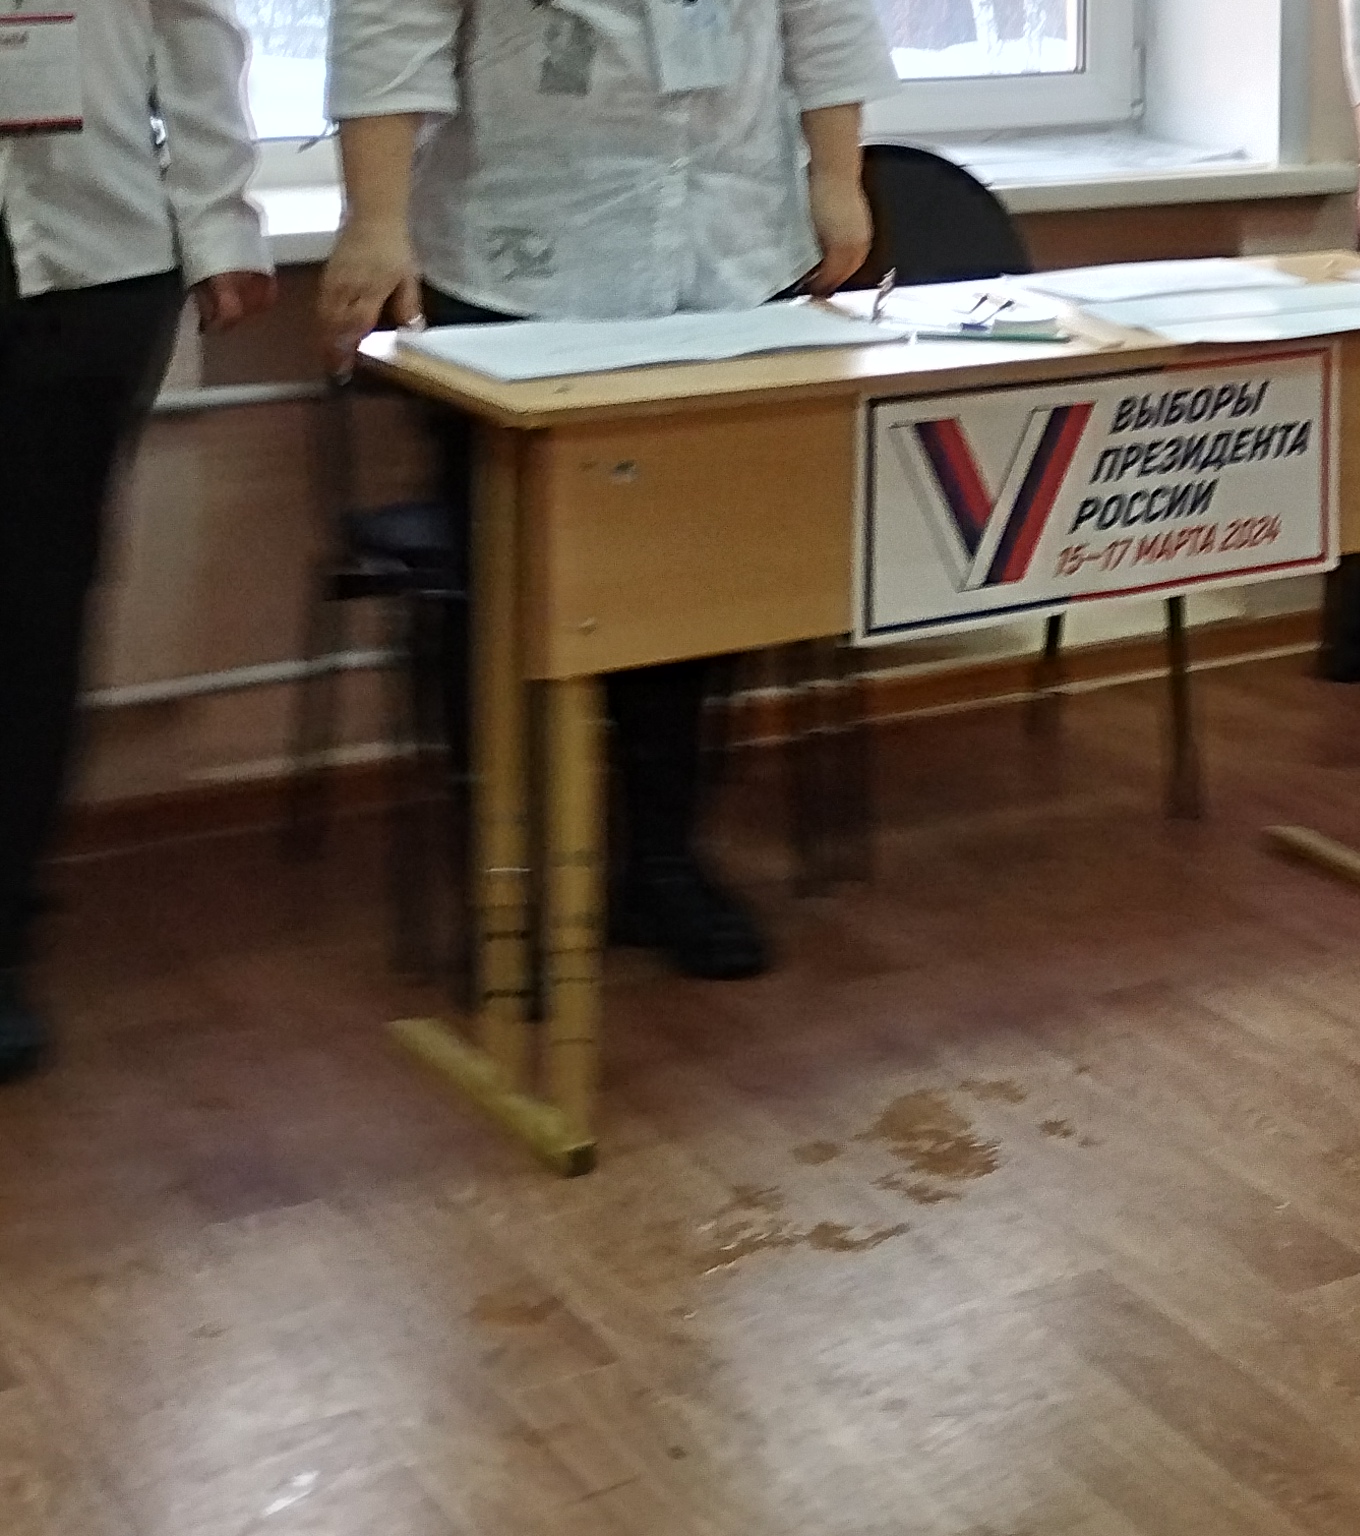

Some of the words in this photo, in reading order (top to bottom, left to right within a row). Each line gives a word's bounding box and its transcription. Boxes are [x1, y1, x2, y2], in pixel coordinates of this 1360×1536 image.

[1109, 381, 1270, 435] ВЫБОРЫ
[1089, 419, 1313, 485] ПРЕЗИДЕНТА
[1066, 478, 1220, 535] РОССИИ
[1133, 524, 1219, 564] МАРТА
[1219, 513, 1283, 554] 2024
